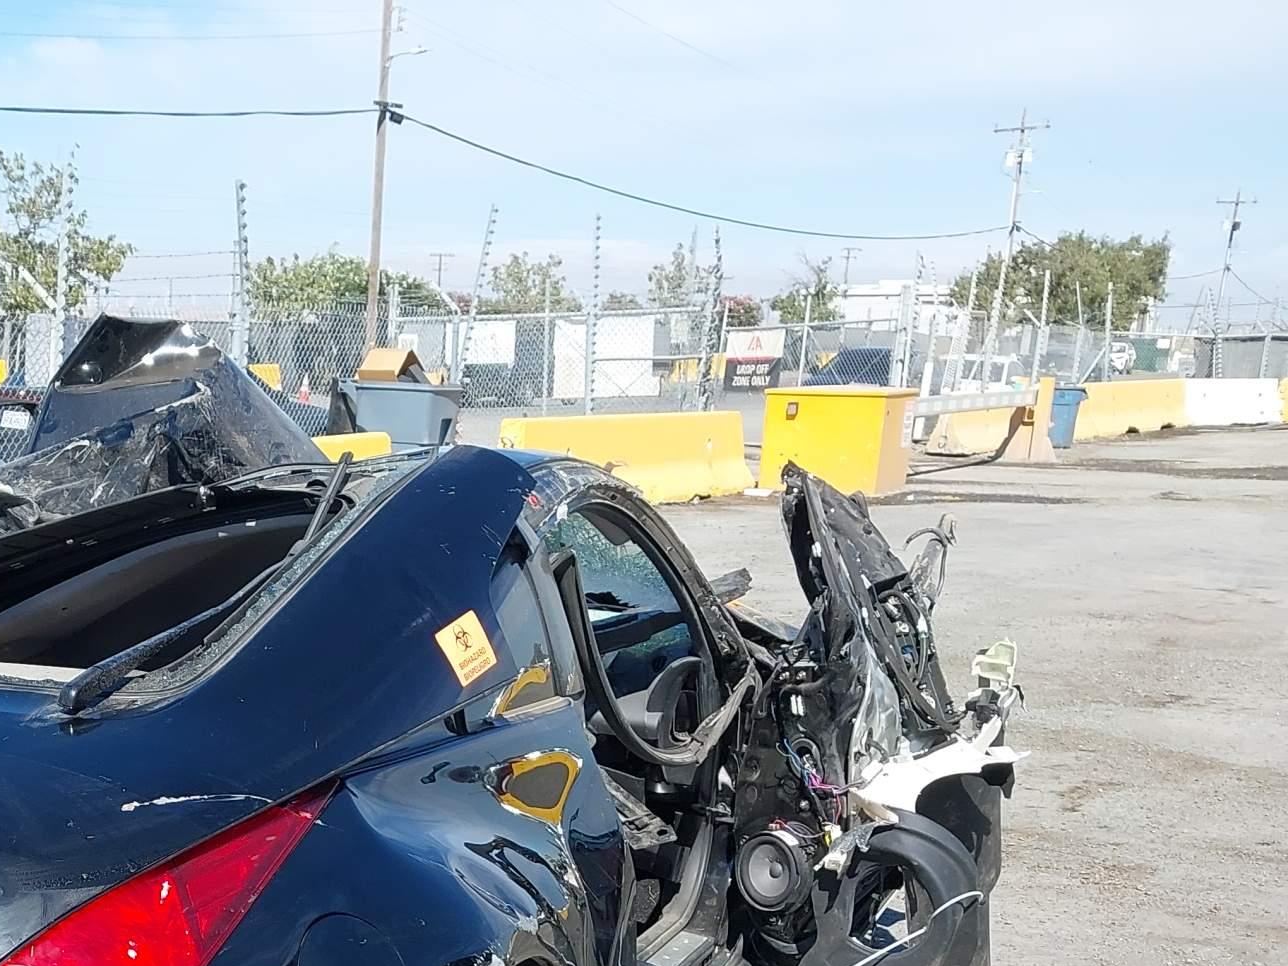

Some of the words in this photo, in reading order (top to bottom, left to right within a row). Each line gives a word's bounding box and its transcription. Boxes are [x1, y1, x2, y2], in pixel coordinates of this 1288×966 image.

[756, 363, 770, 375] OFF
[732, 375, 751, 386] ZONE
[751, 375, 771, 386] ONLY
